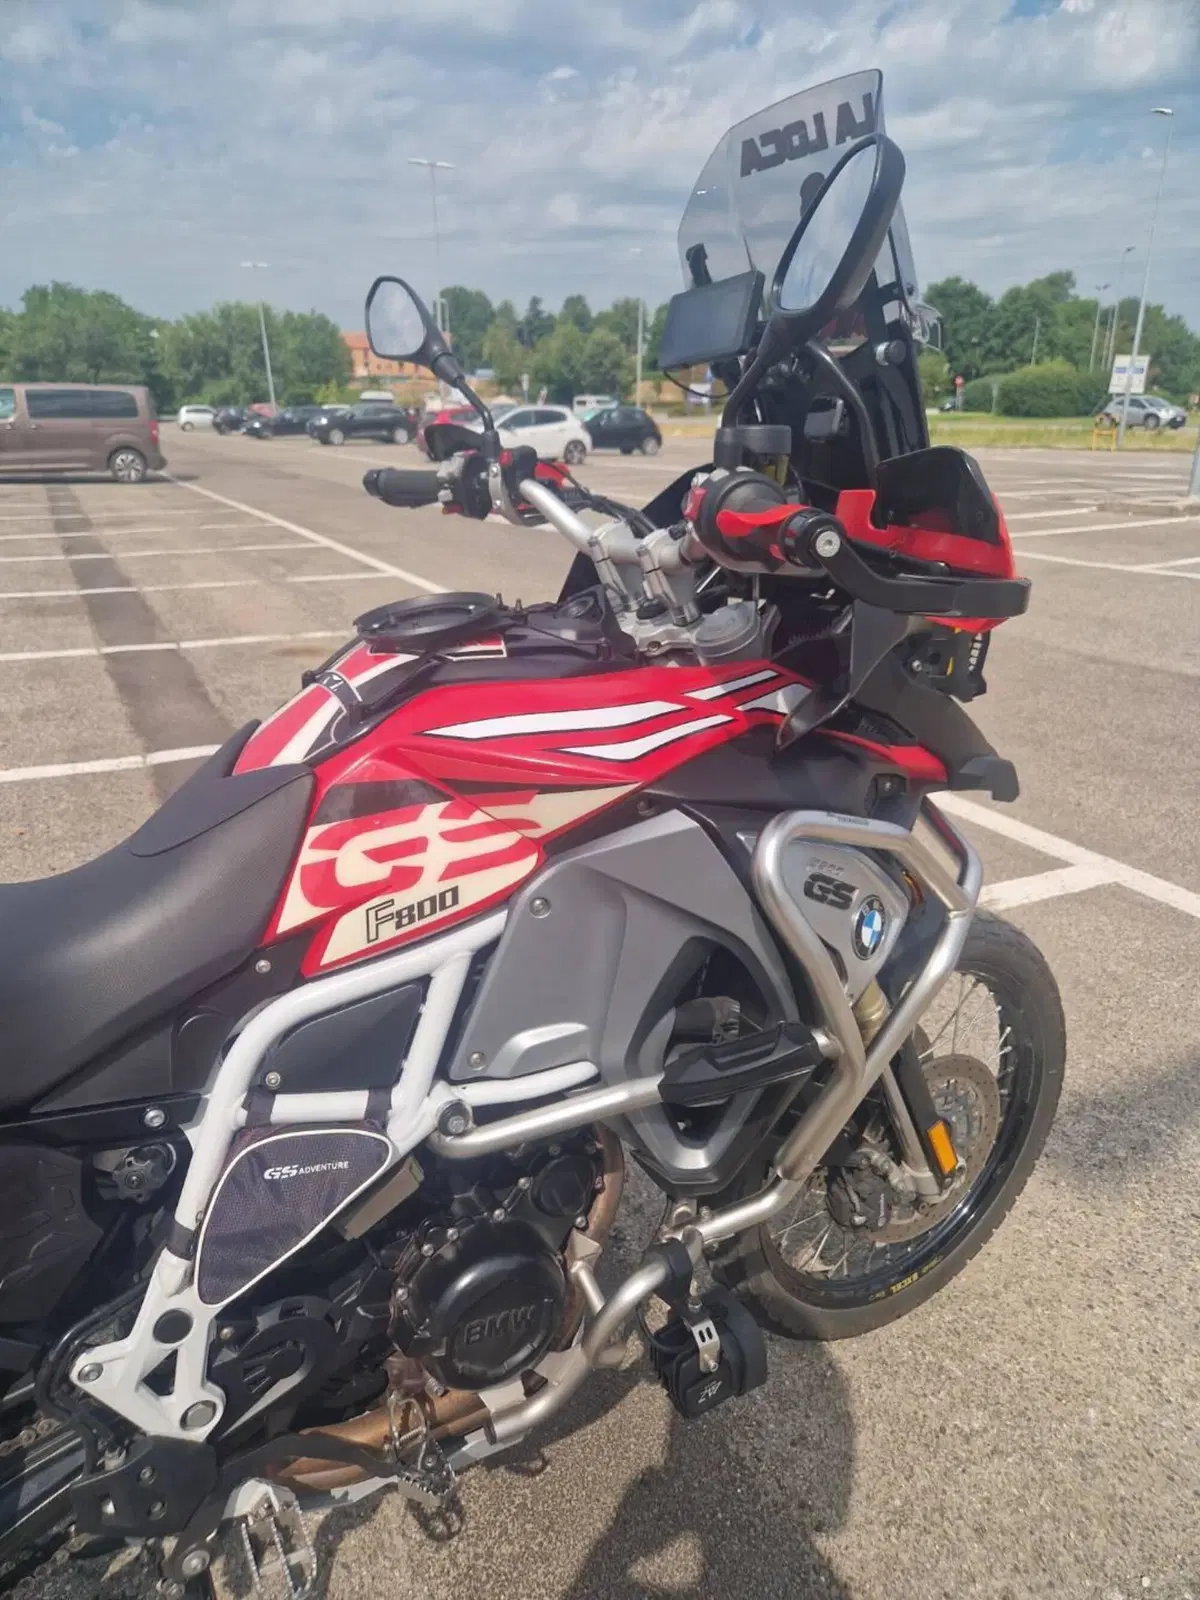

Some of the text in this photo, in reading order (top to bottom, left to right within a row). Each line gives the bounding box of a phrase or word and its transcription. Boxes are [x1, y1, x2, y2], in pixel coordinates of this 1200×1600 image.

[300, 789, 542, 909] GS
[365, 886, 460, 944] F800
[804, 872, 857, 911] GS
[264, 1161, 349, 1180] GS ADVENTURE
